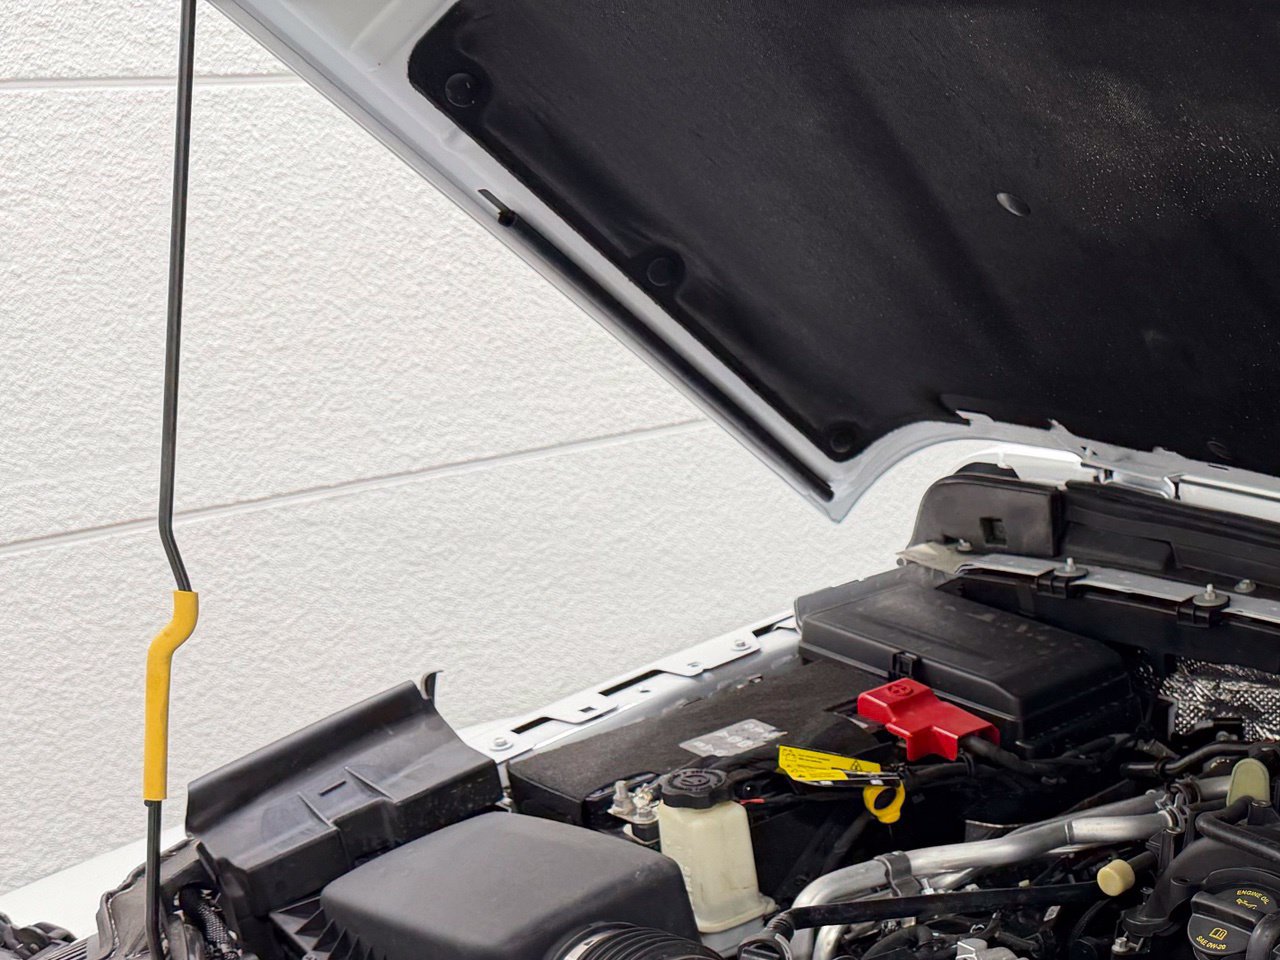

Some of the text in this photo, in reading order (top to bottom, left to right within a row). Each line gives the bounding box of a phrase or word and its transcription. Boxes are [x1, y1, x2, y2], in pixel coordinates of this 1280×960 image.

[1236, 889, 1270, 905] ENGINE OIL
[1196, 935, 1227, 950] SAE 0W-20
